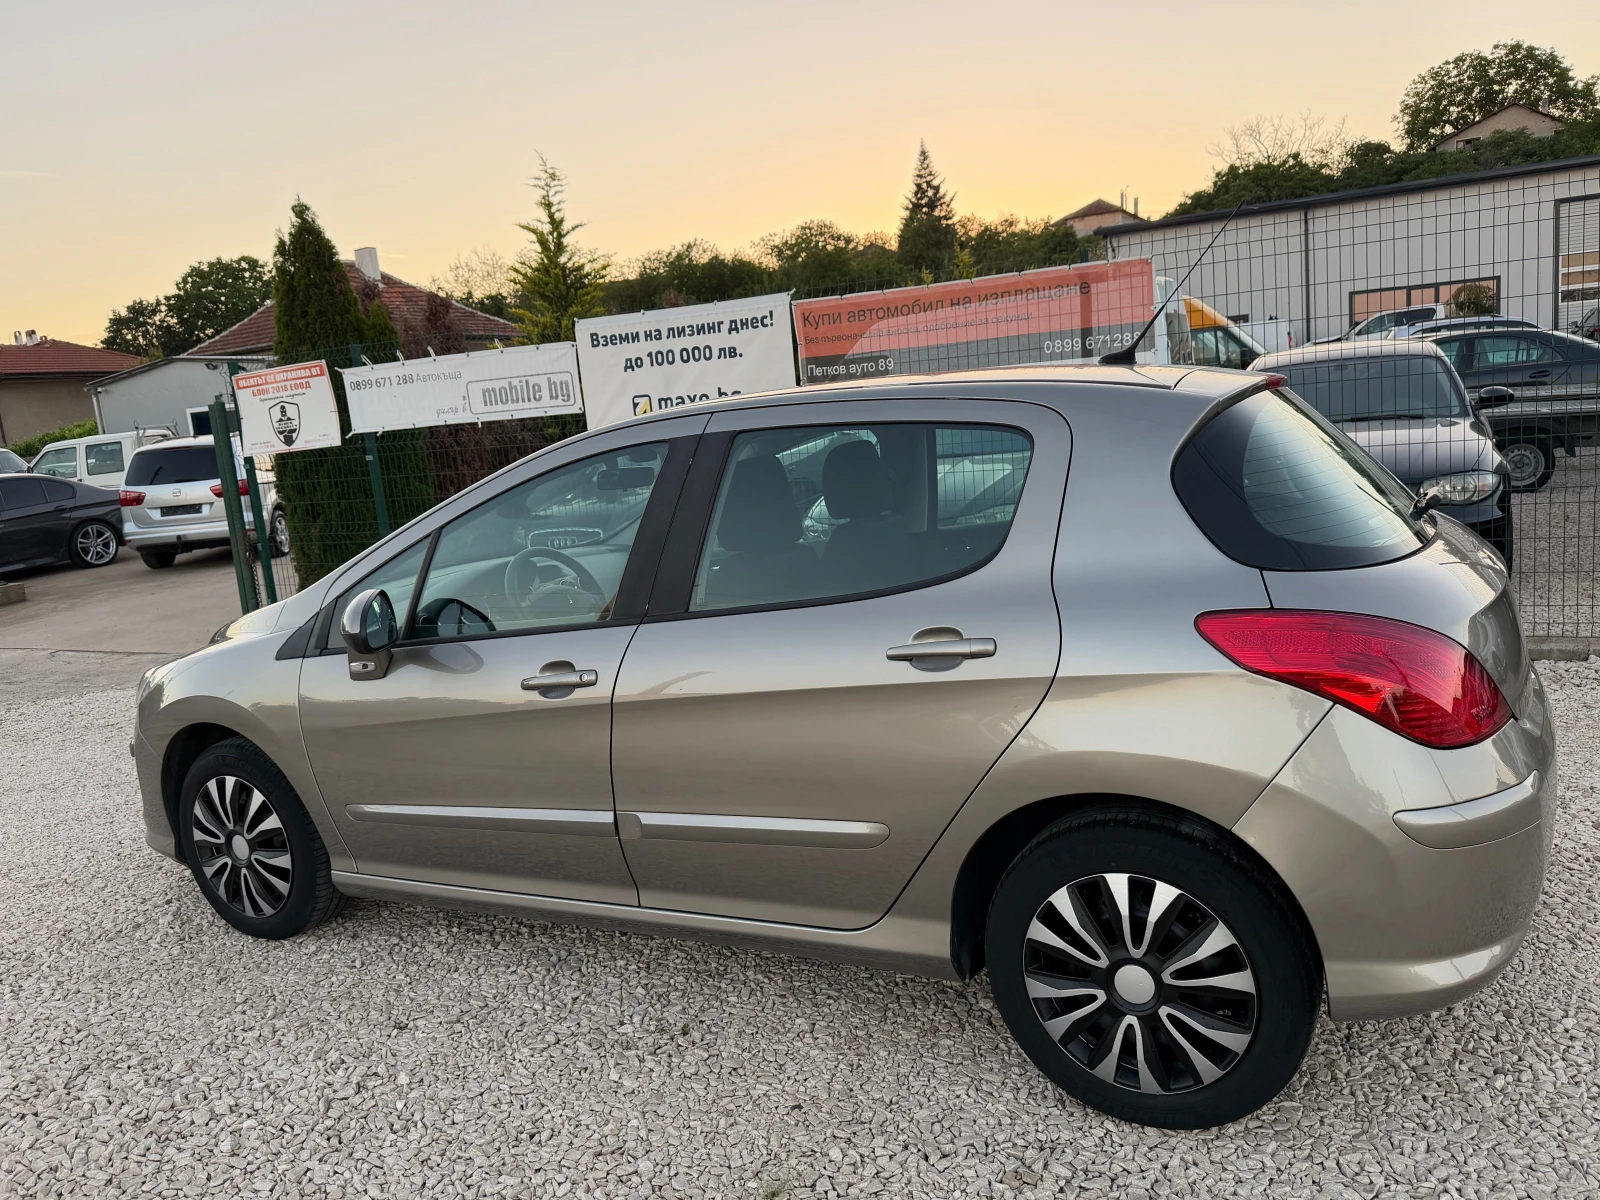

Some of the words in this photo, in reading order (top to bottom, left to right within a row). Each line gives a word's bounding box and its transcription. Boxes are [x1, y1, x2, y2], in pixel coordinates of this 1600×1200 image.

[802, 311, 842, 330] Купи
[847, 299, 944, 322] автомобил
[950, 295, 972, 310] на
[978, 280, 1091, 306] изплащане
[590, 331, 640, 348] Вземи
[644, 328, 662, 342] на
[666, 320, 724, 339] лизинг
[727, 310, 774, 334] днес!
[804, 335, 819, 345] Без
[991, 311, 1034, 324] секунди
[1044, 337, 1081, 354] 0899
[623, 356, 644, 372] до
[647, 349, 675, 367] 100
[679, 344, 713, 364] 000
[717, 345, 743, 360] лв.
[807, 363, 846, 377] Петков
[850, 361, 876, 376] ауто
[878, 358, 894, 371] 89
[266, 373, 276, 382] СЕ
[276, 369, 311, 381] ОХРАНЯВА
[311, 367, 321, 376] ОТ
[289, 381, 312, 391] ЕООД
[349, 378, 373, 391] 0899
[375, 376, 393, 388] 671
[396, 373, 415, 386] 288
[416, 370, 462, 383] Автокъща
[481, 379, 543, 407] mobile
[546, 377, 571, 403] bg
